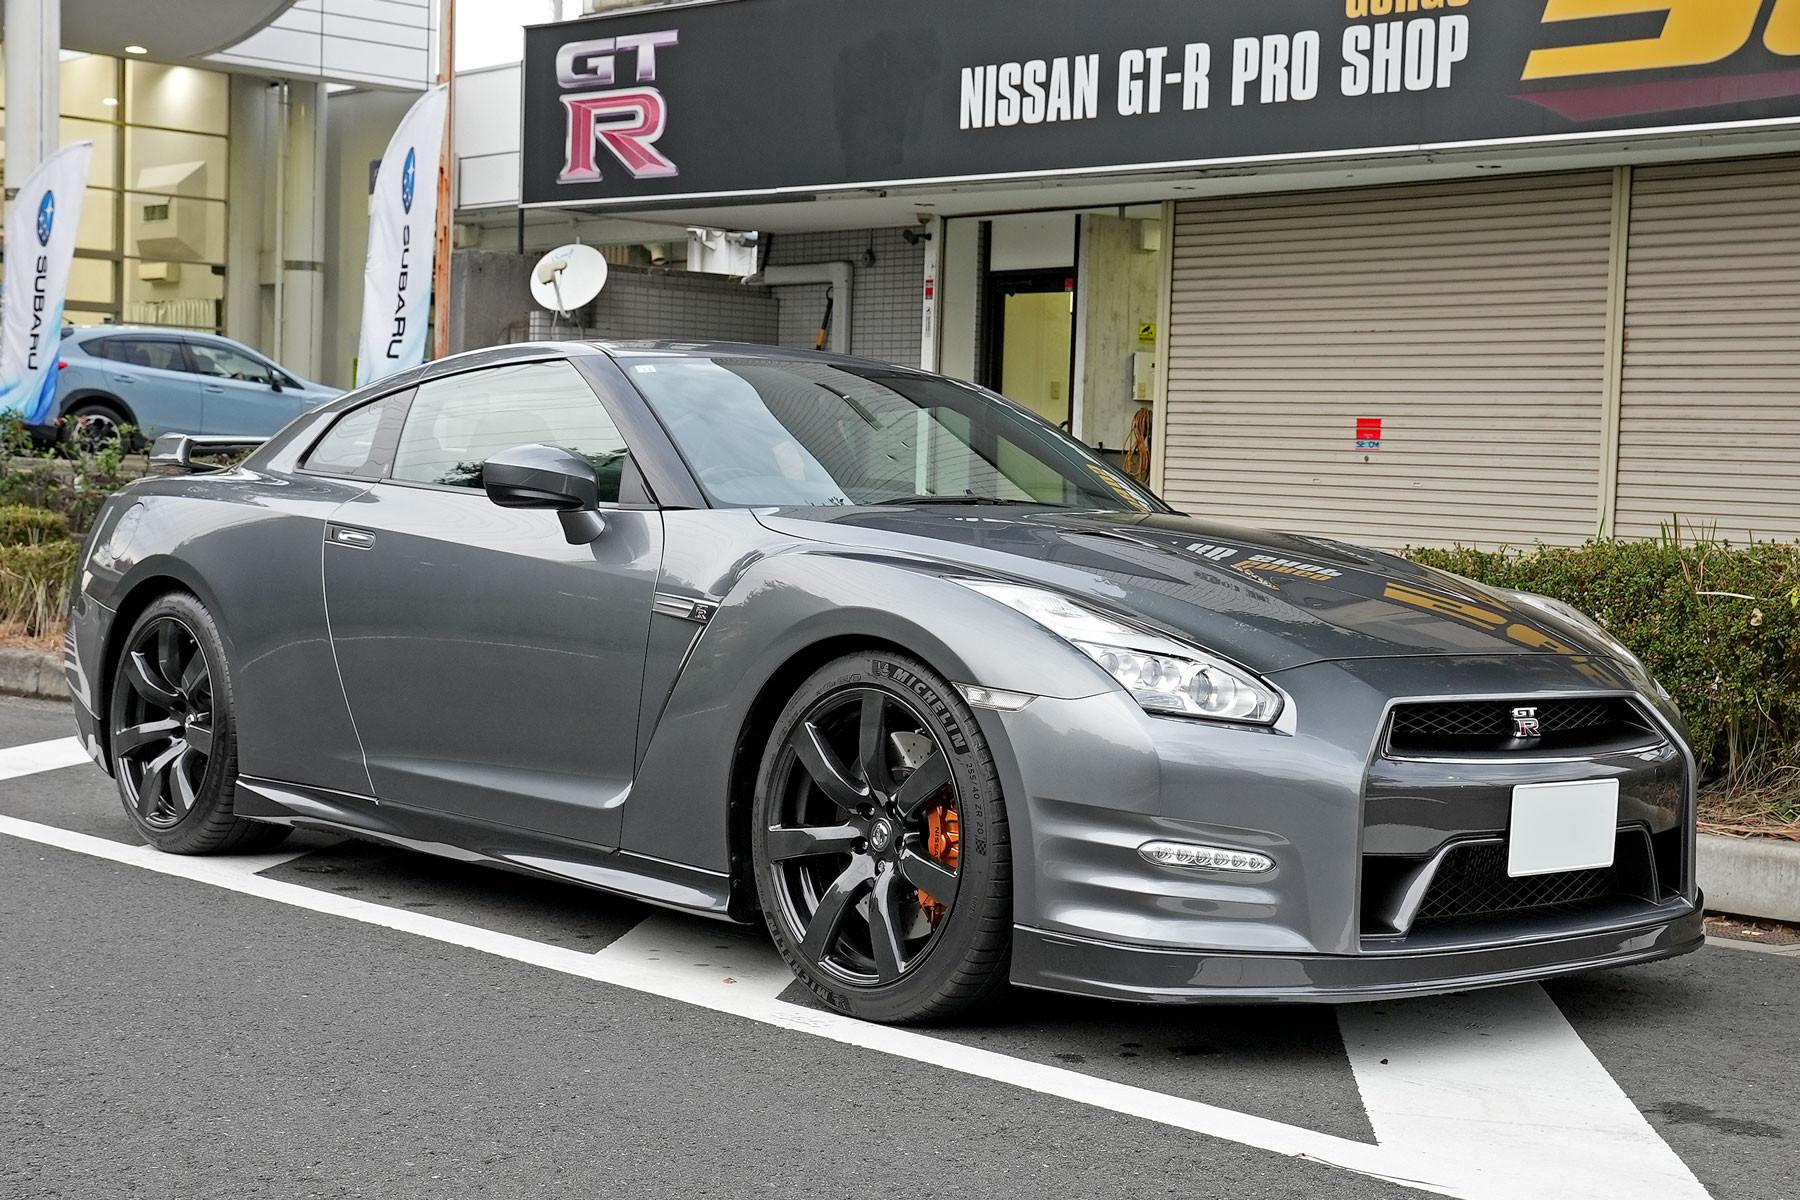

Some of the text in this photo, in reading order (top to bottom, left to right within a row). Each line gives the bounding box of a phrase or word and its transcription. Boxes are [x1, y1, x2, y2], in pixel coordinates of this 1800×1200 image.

[960, 14, 1469, 130] NISSAN GT-R PRO SHOP
[386, 225, 410, 359] SUBARU
[28, 256, 47, 370] SUBARU
[892, 668, 966, 749] MICHELIN
[1511, 706, 1538, 718] GT
[1512, 717, 1541, 737] R
[966, 763, 980, 800] 255/40
[975, 804, 983, 817] ZR
[976, 821, 984, 835] 20
